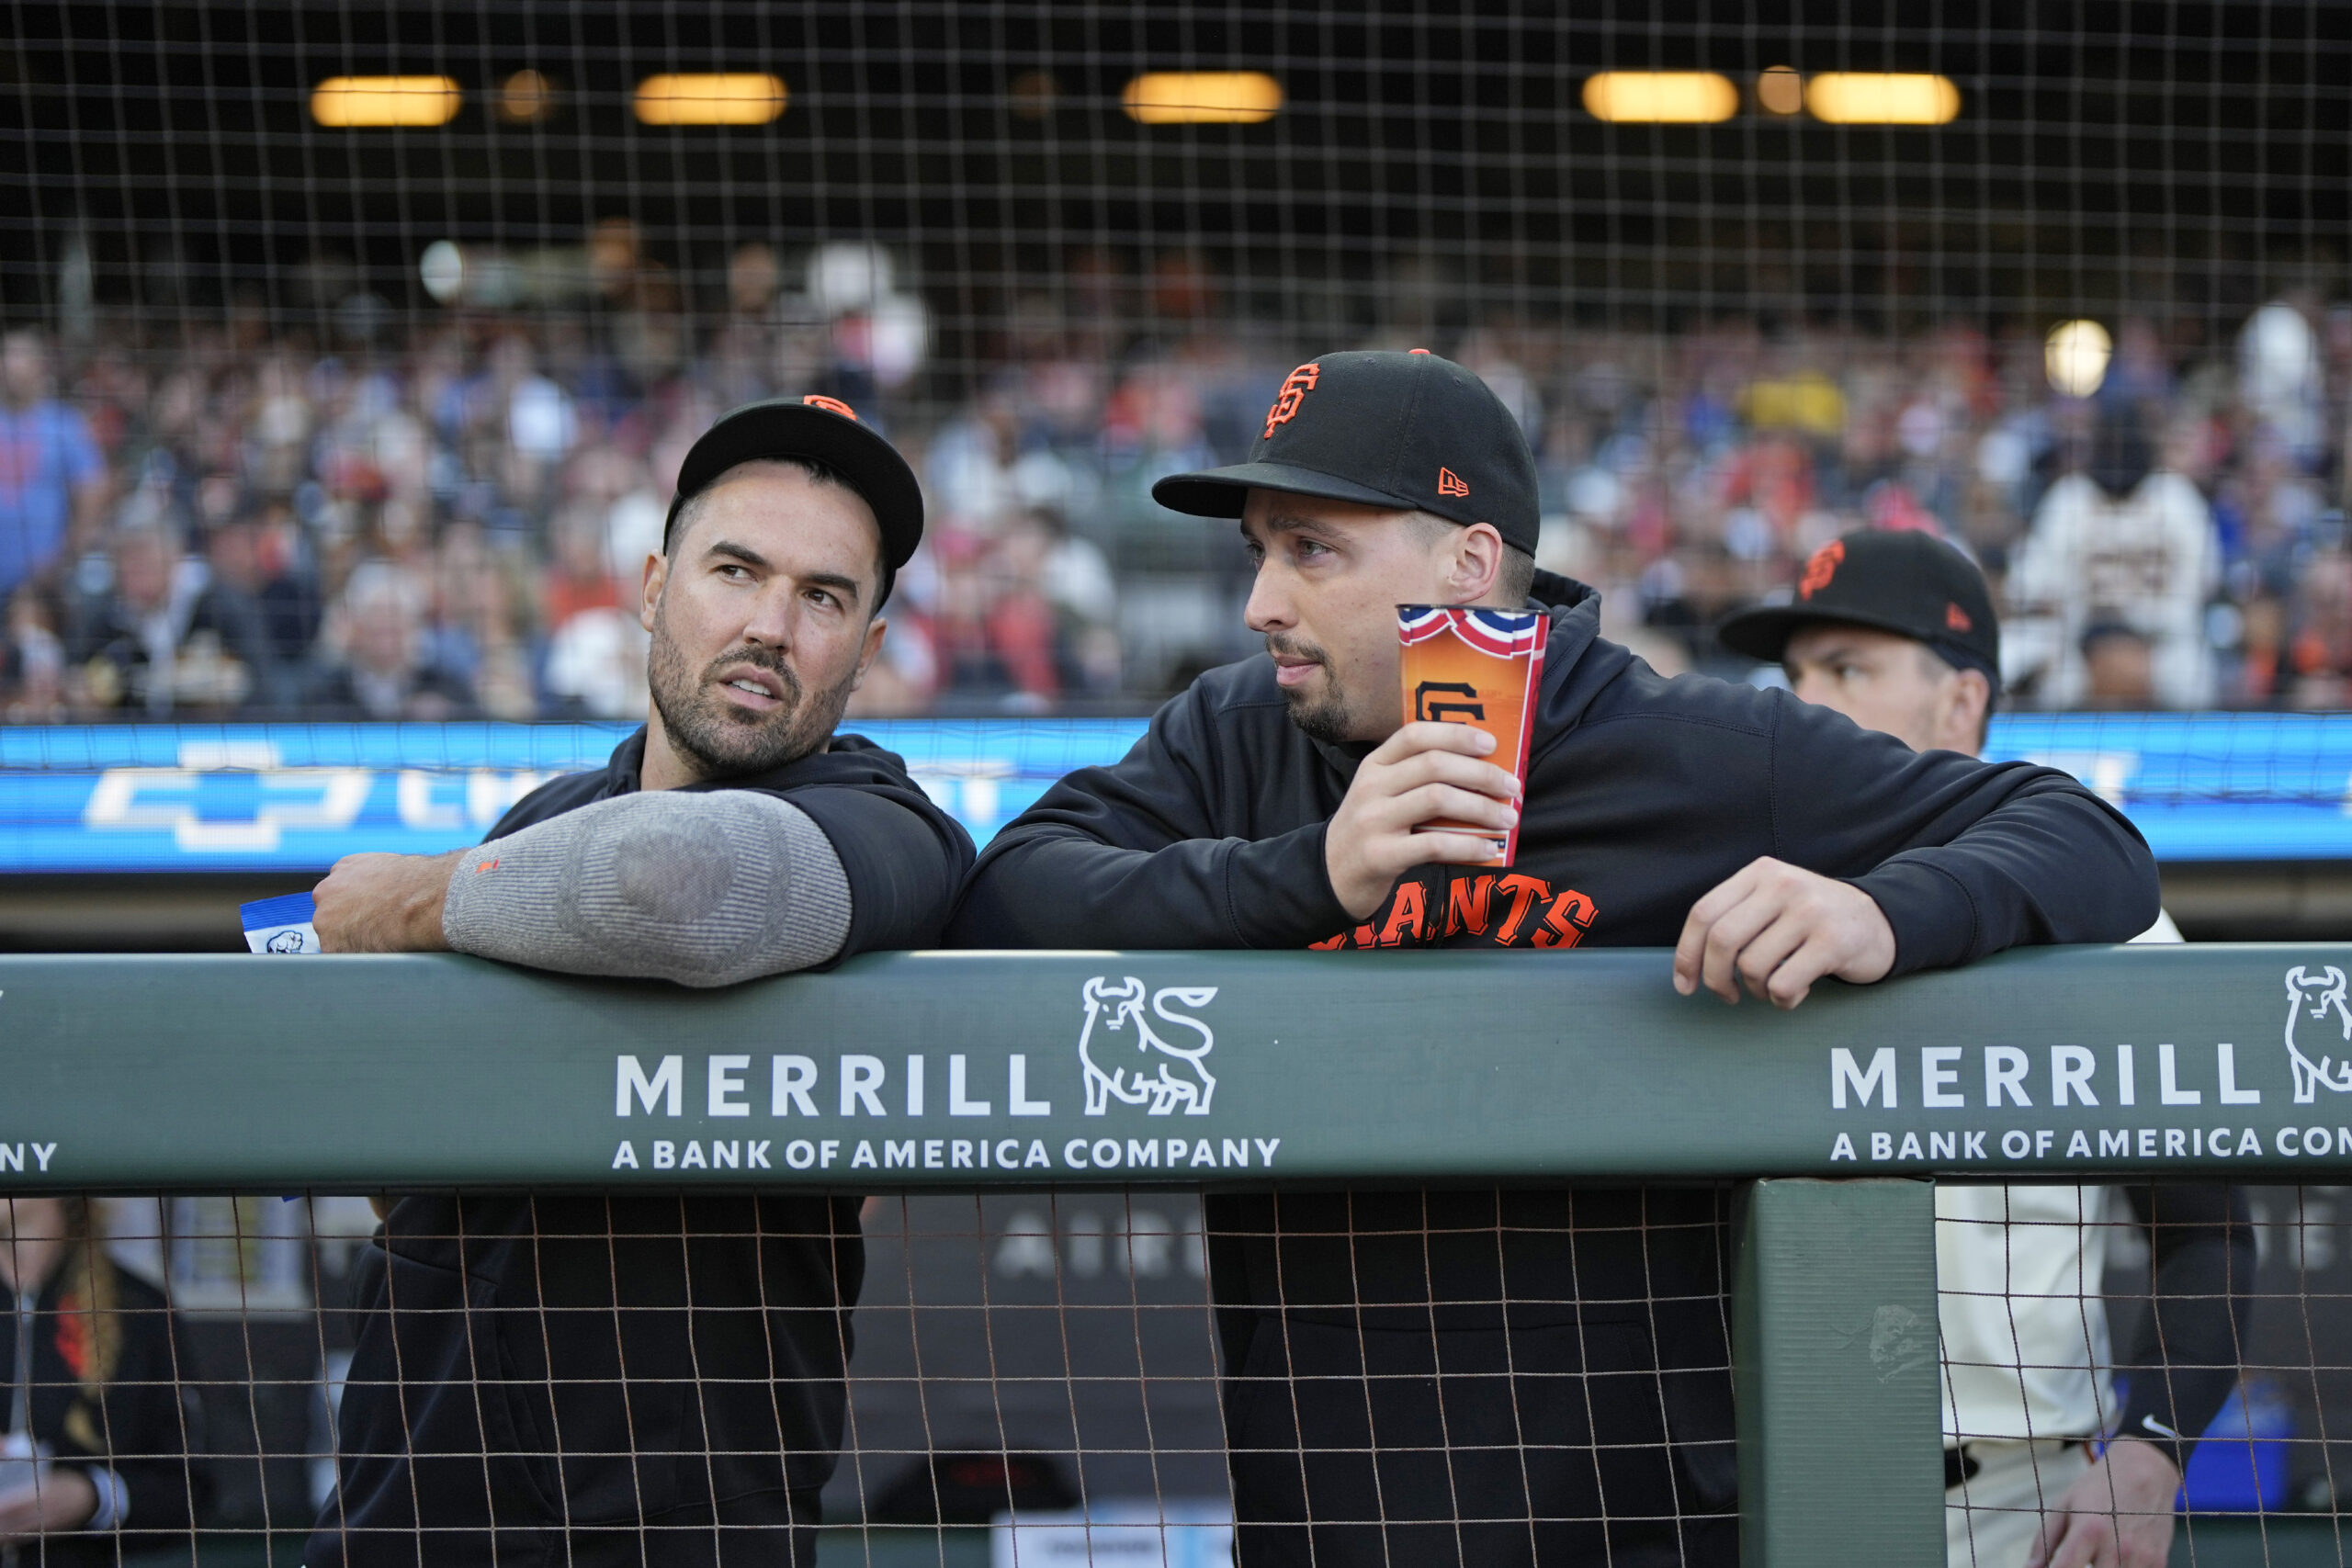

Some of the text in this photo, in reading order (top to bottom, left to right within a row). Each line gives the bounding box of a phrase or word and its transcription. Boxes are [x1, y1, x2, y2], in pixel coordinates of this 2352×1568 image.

[1263, 363, 1320, 440] SF
[1307, 874, 1600, 950] ANTS
[616, 1055, 1051, 1117] MERRILL
[1831, 1043, 2261, 1109] MERRILL
[613, 1138, 1281, 1168] A BANK OF AMERICA COMPANY
[1831, 1134, 1856, 1160] A
[1871, 1131, 1987, 1160] BANK
[2002, 1130, 2054, 1158] OF
[2067, 1128, 2263, 1157] AMERICA
